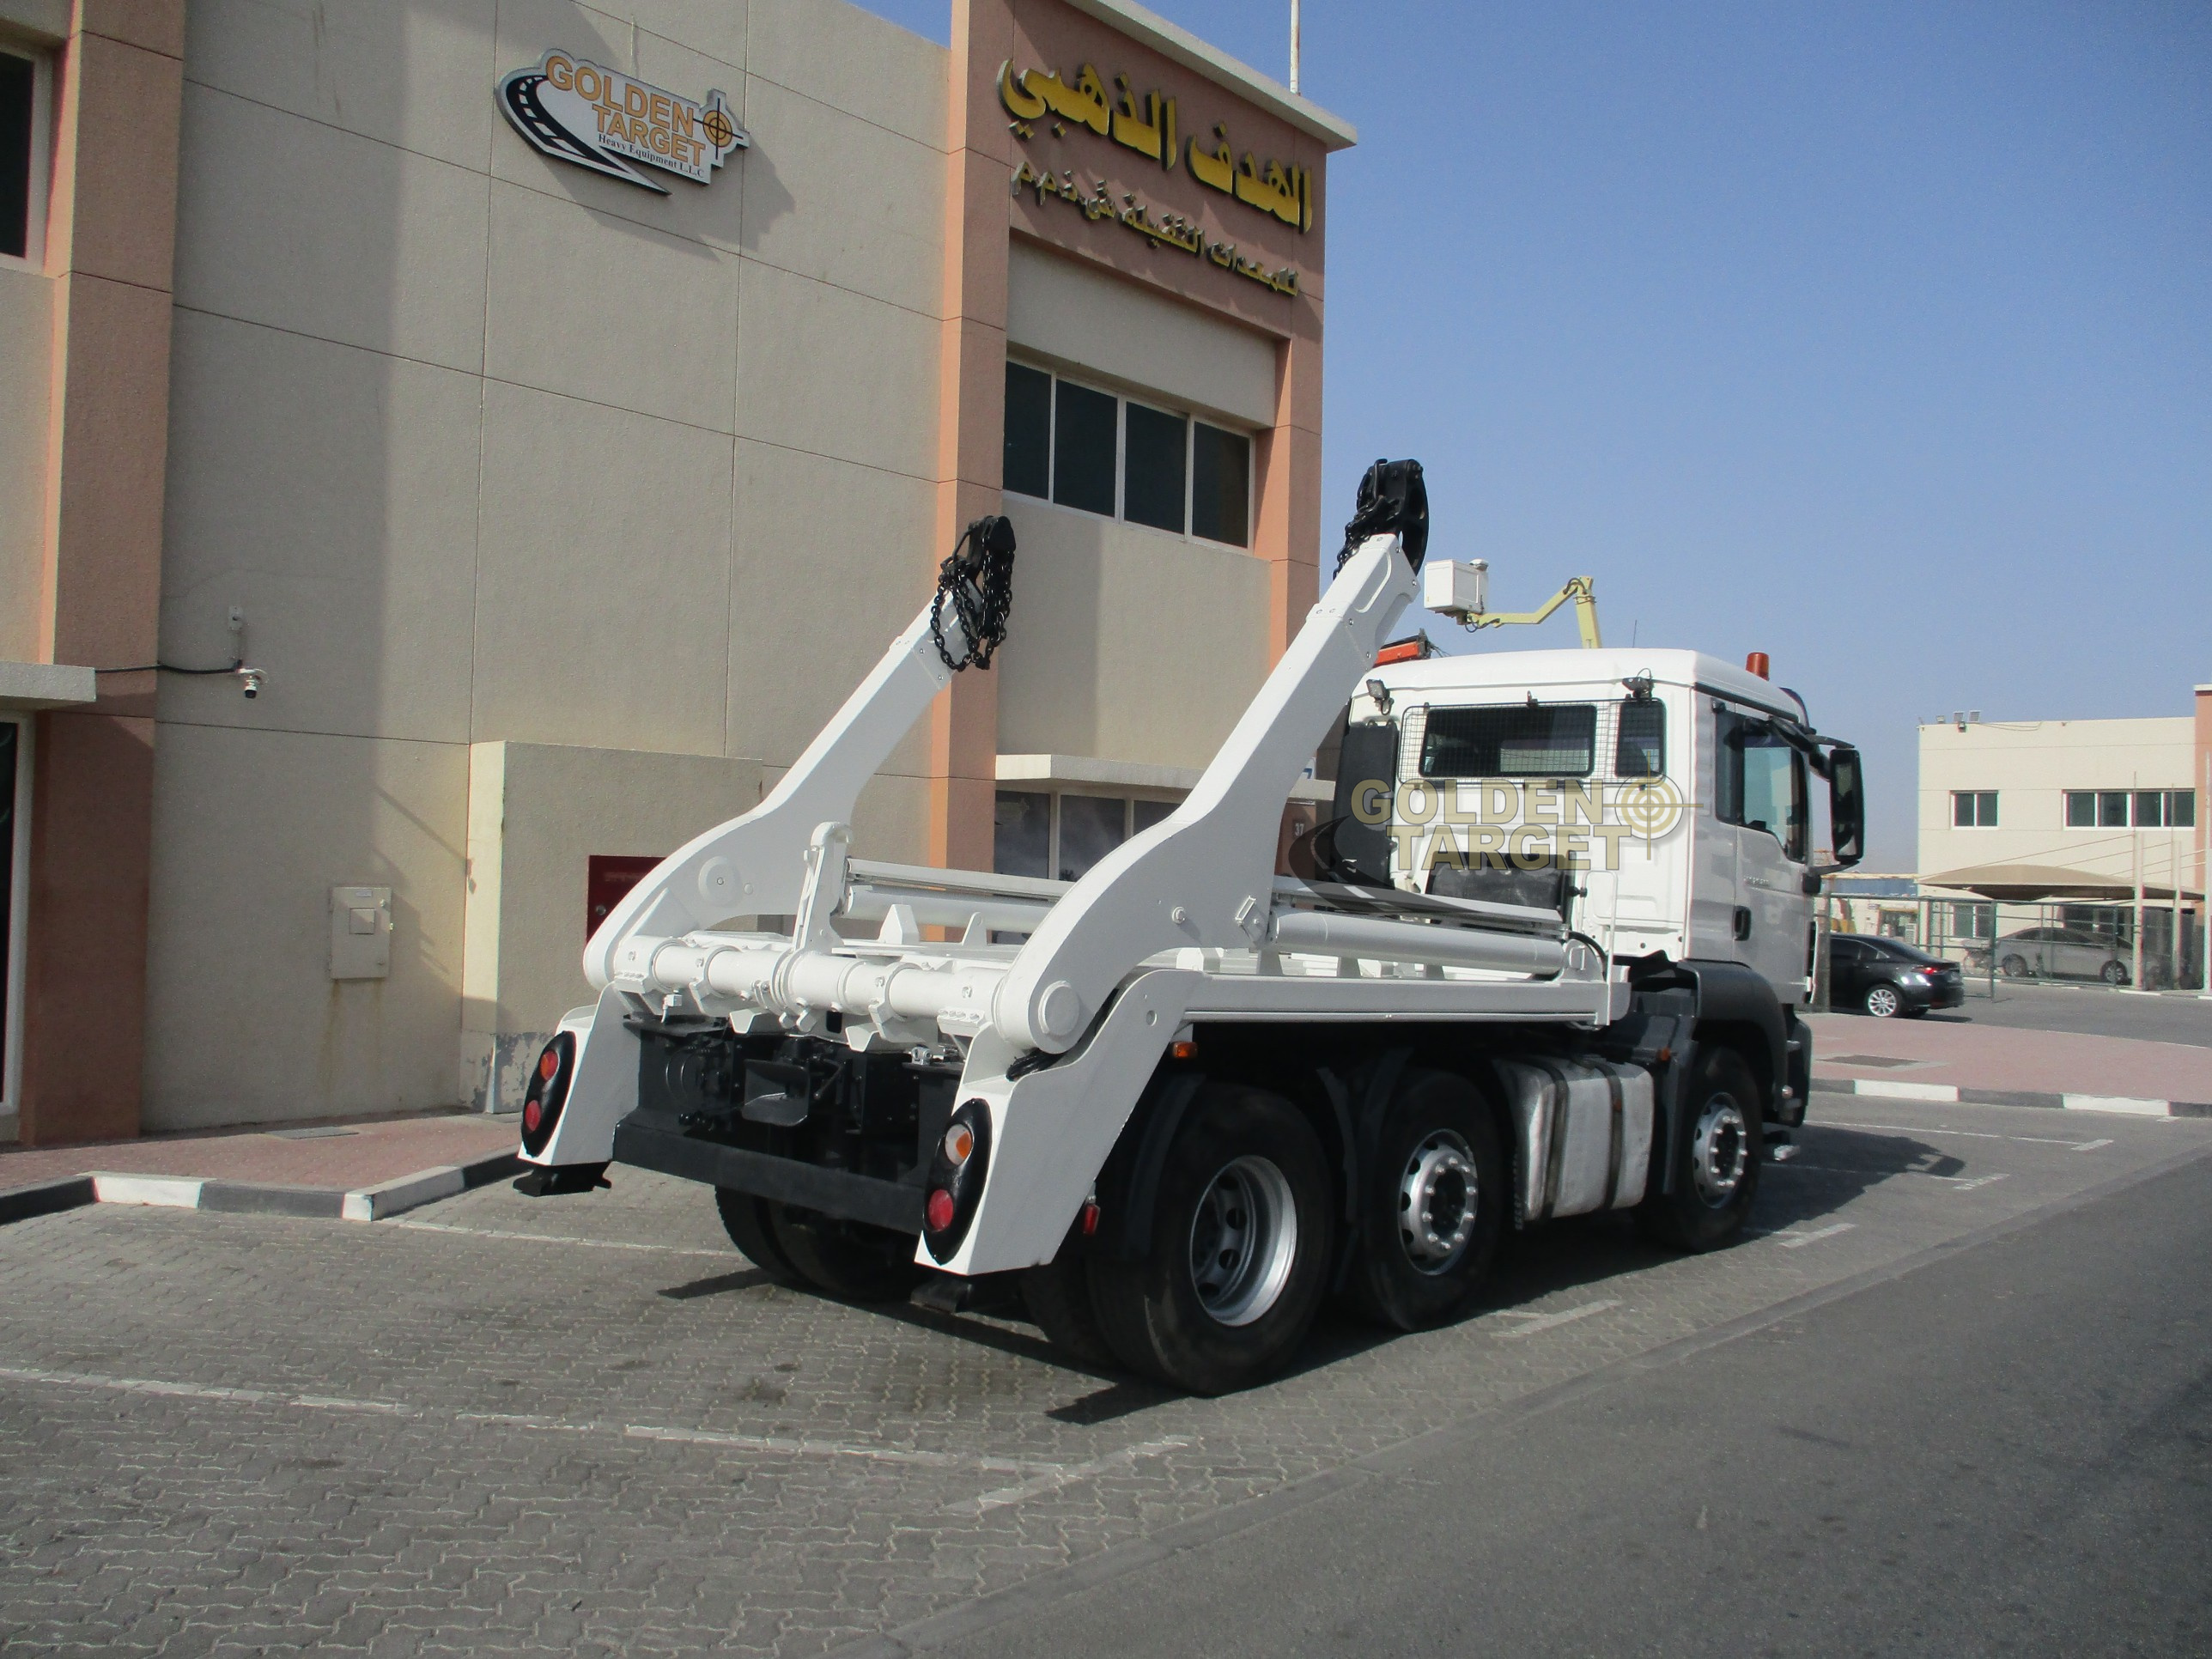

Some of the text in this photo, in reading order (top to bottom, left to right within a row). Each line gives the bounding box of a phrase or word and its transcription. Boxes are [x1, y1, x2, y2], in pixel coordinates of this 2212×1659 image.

[545, 55, 694, 137] GOLDEN
[592, 104, 706, 167] TARGET
[599, 132, 627, 149] Heavy
[629, 143, 677, 168] Equipment
[996, 58, 1312, 234] الهدف الذهبي
[1121, 193, 1206, 258] الثقيلة
